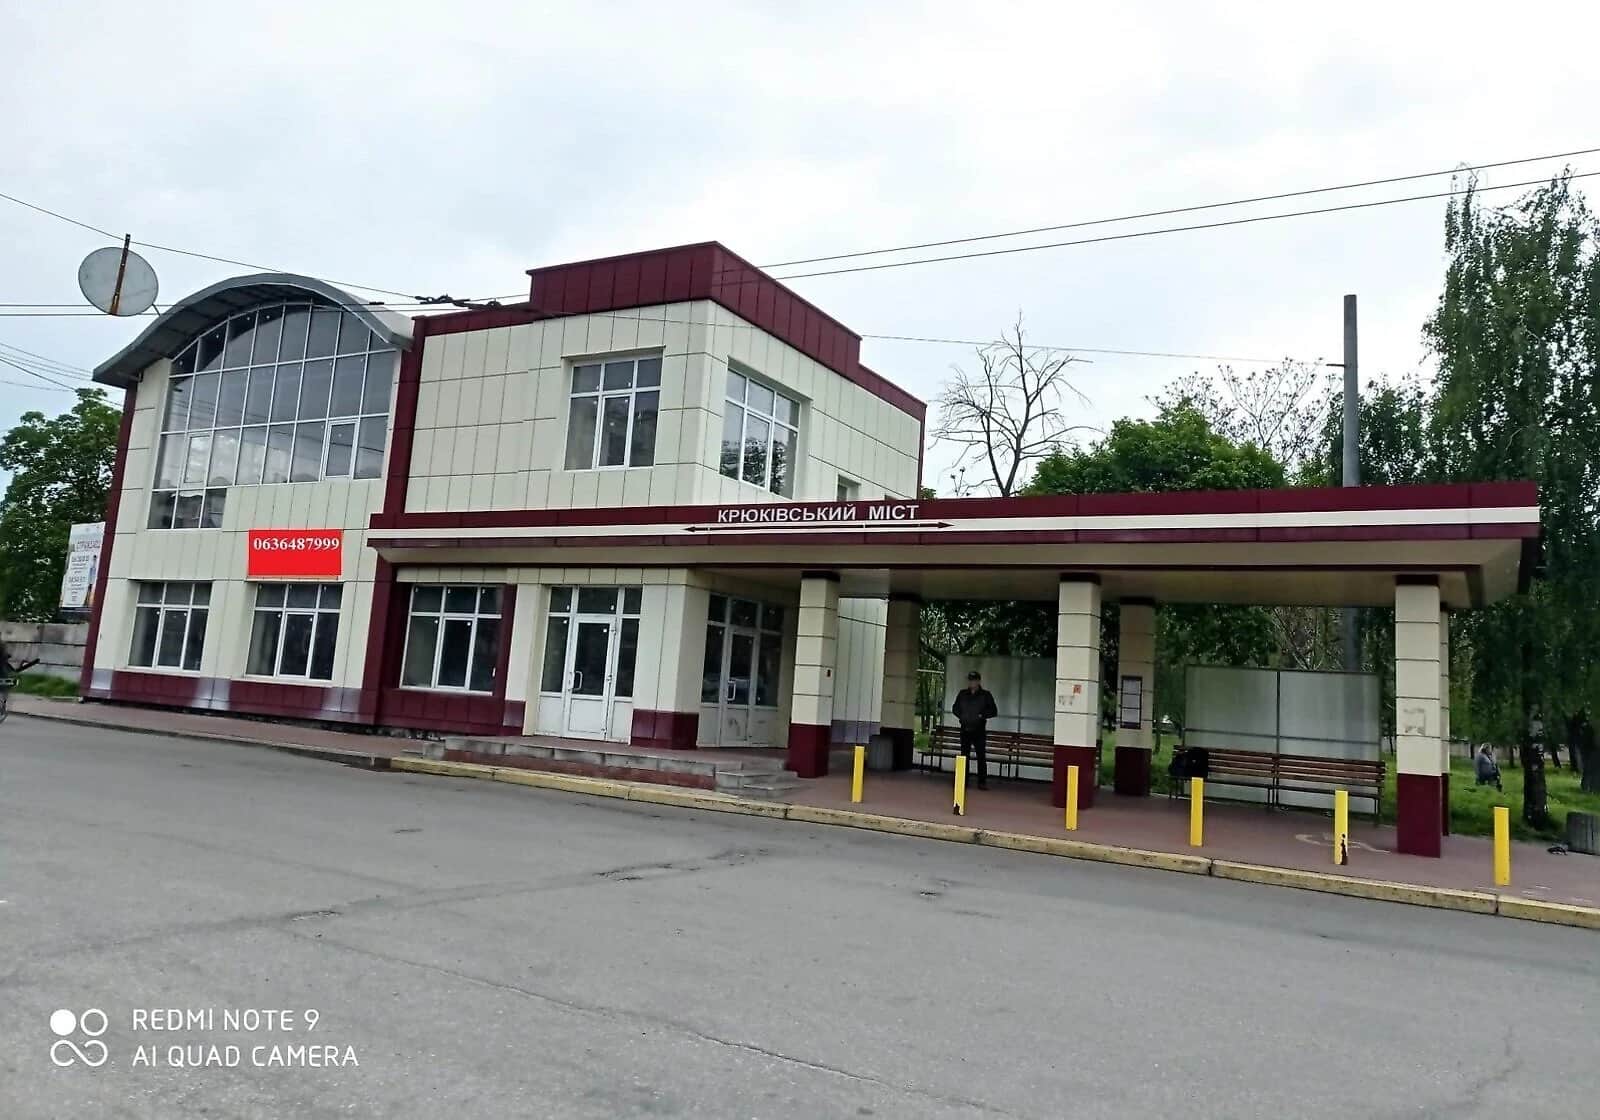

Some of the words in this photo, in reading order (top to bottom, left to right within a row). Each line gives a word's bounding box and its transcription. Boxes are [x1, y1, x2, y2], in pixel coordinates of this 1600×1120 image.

[717, 503, 857, 524] КРЮКІВСЬКИЙ
[868, 504, 920, 521] МІСТ
[253, 537, 340, 551] 0636487999
